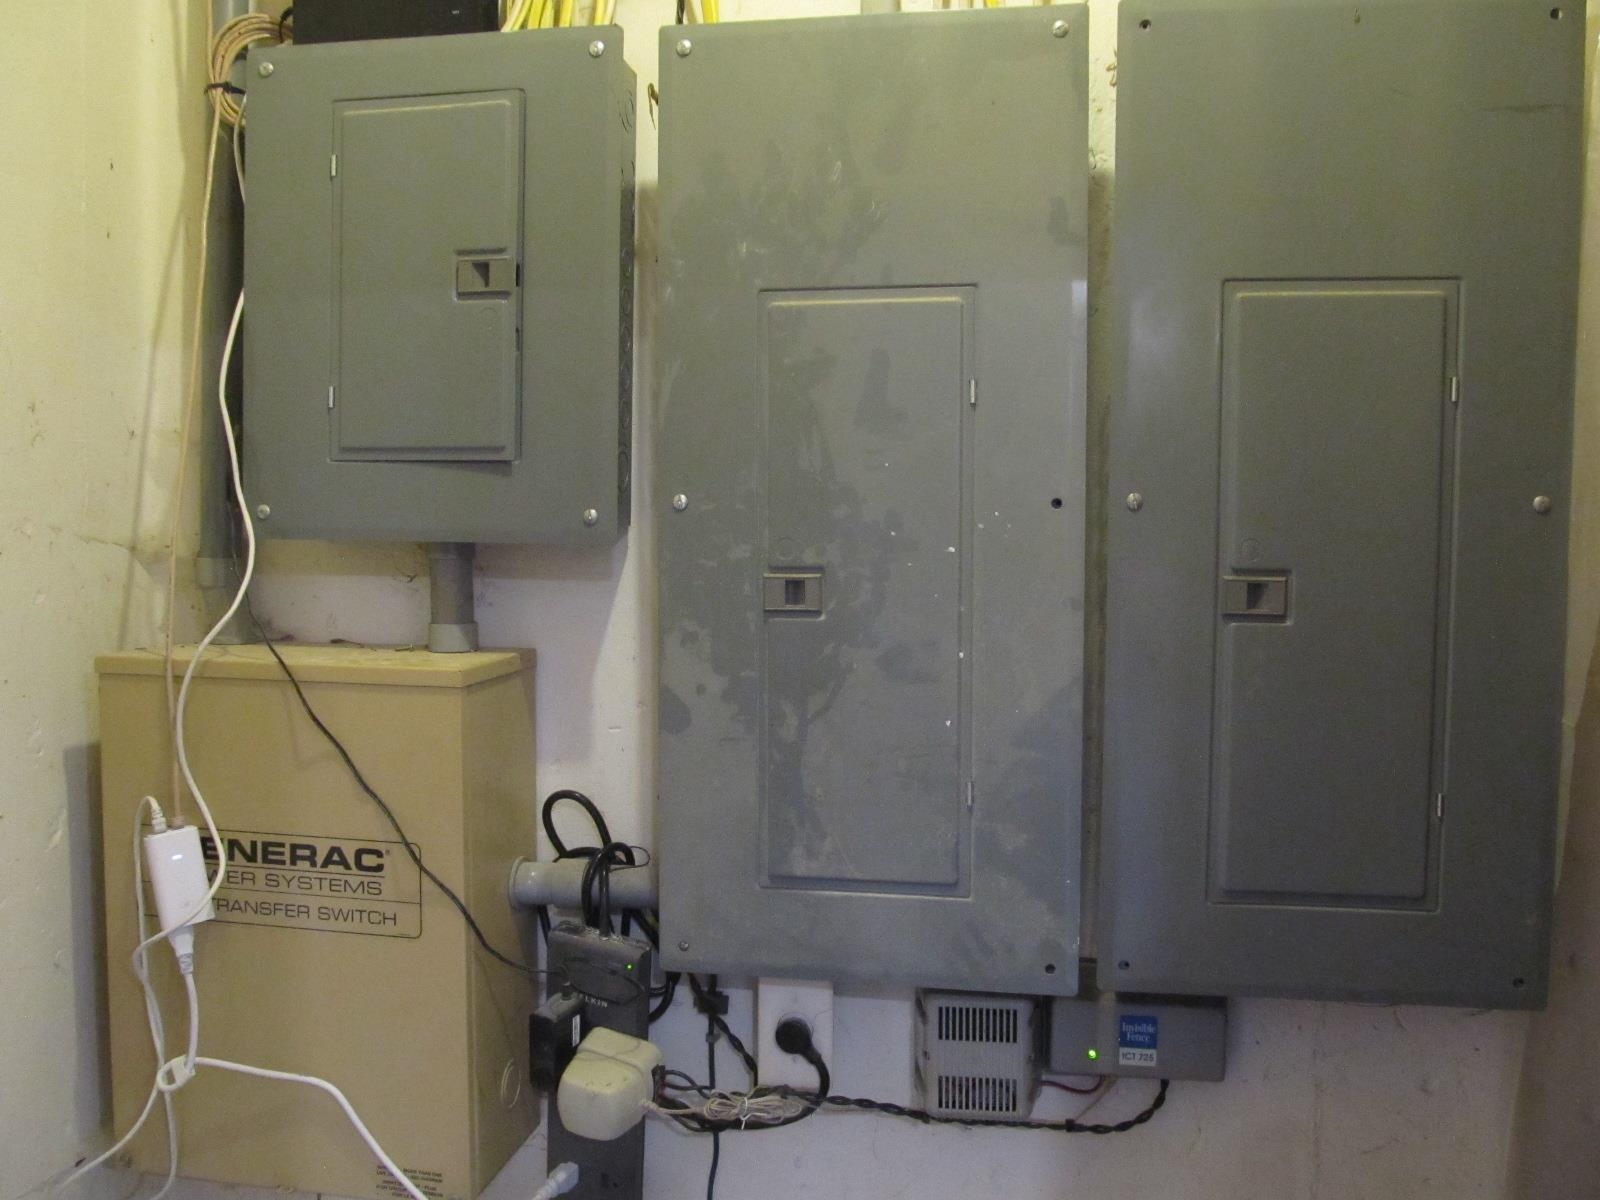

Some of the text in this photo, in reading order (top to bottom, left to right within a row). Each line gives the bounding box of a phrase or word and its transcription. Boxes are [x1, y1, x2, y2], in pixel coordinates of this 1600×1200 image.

[200, 836, 385, 873] ENERAC
[264, 872, 383, 896] SYSTEMS
[317, 908, 397, 927] SWITCH
[584, 995, 608, 1008] LKIN
[1122, 1022, 1156, 1033] Invisible
[1127, 1033, 1152, 1042] Fence
[1121, 1052, 1136, 1061] ICT
